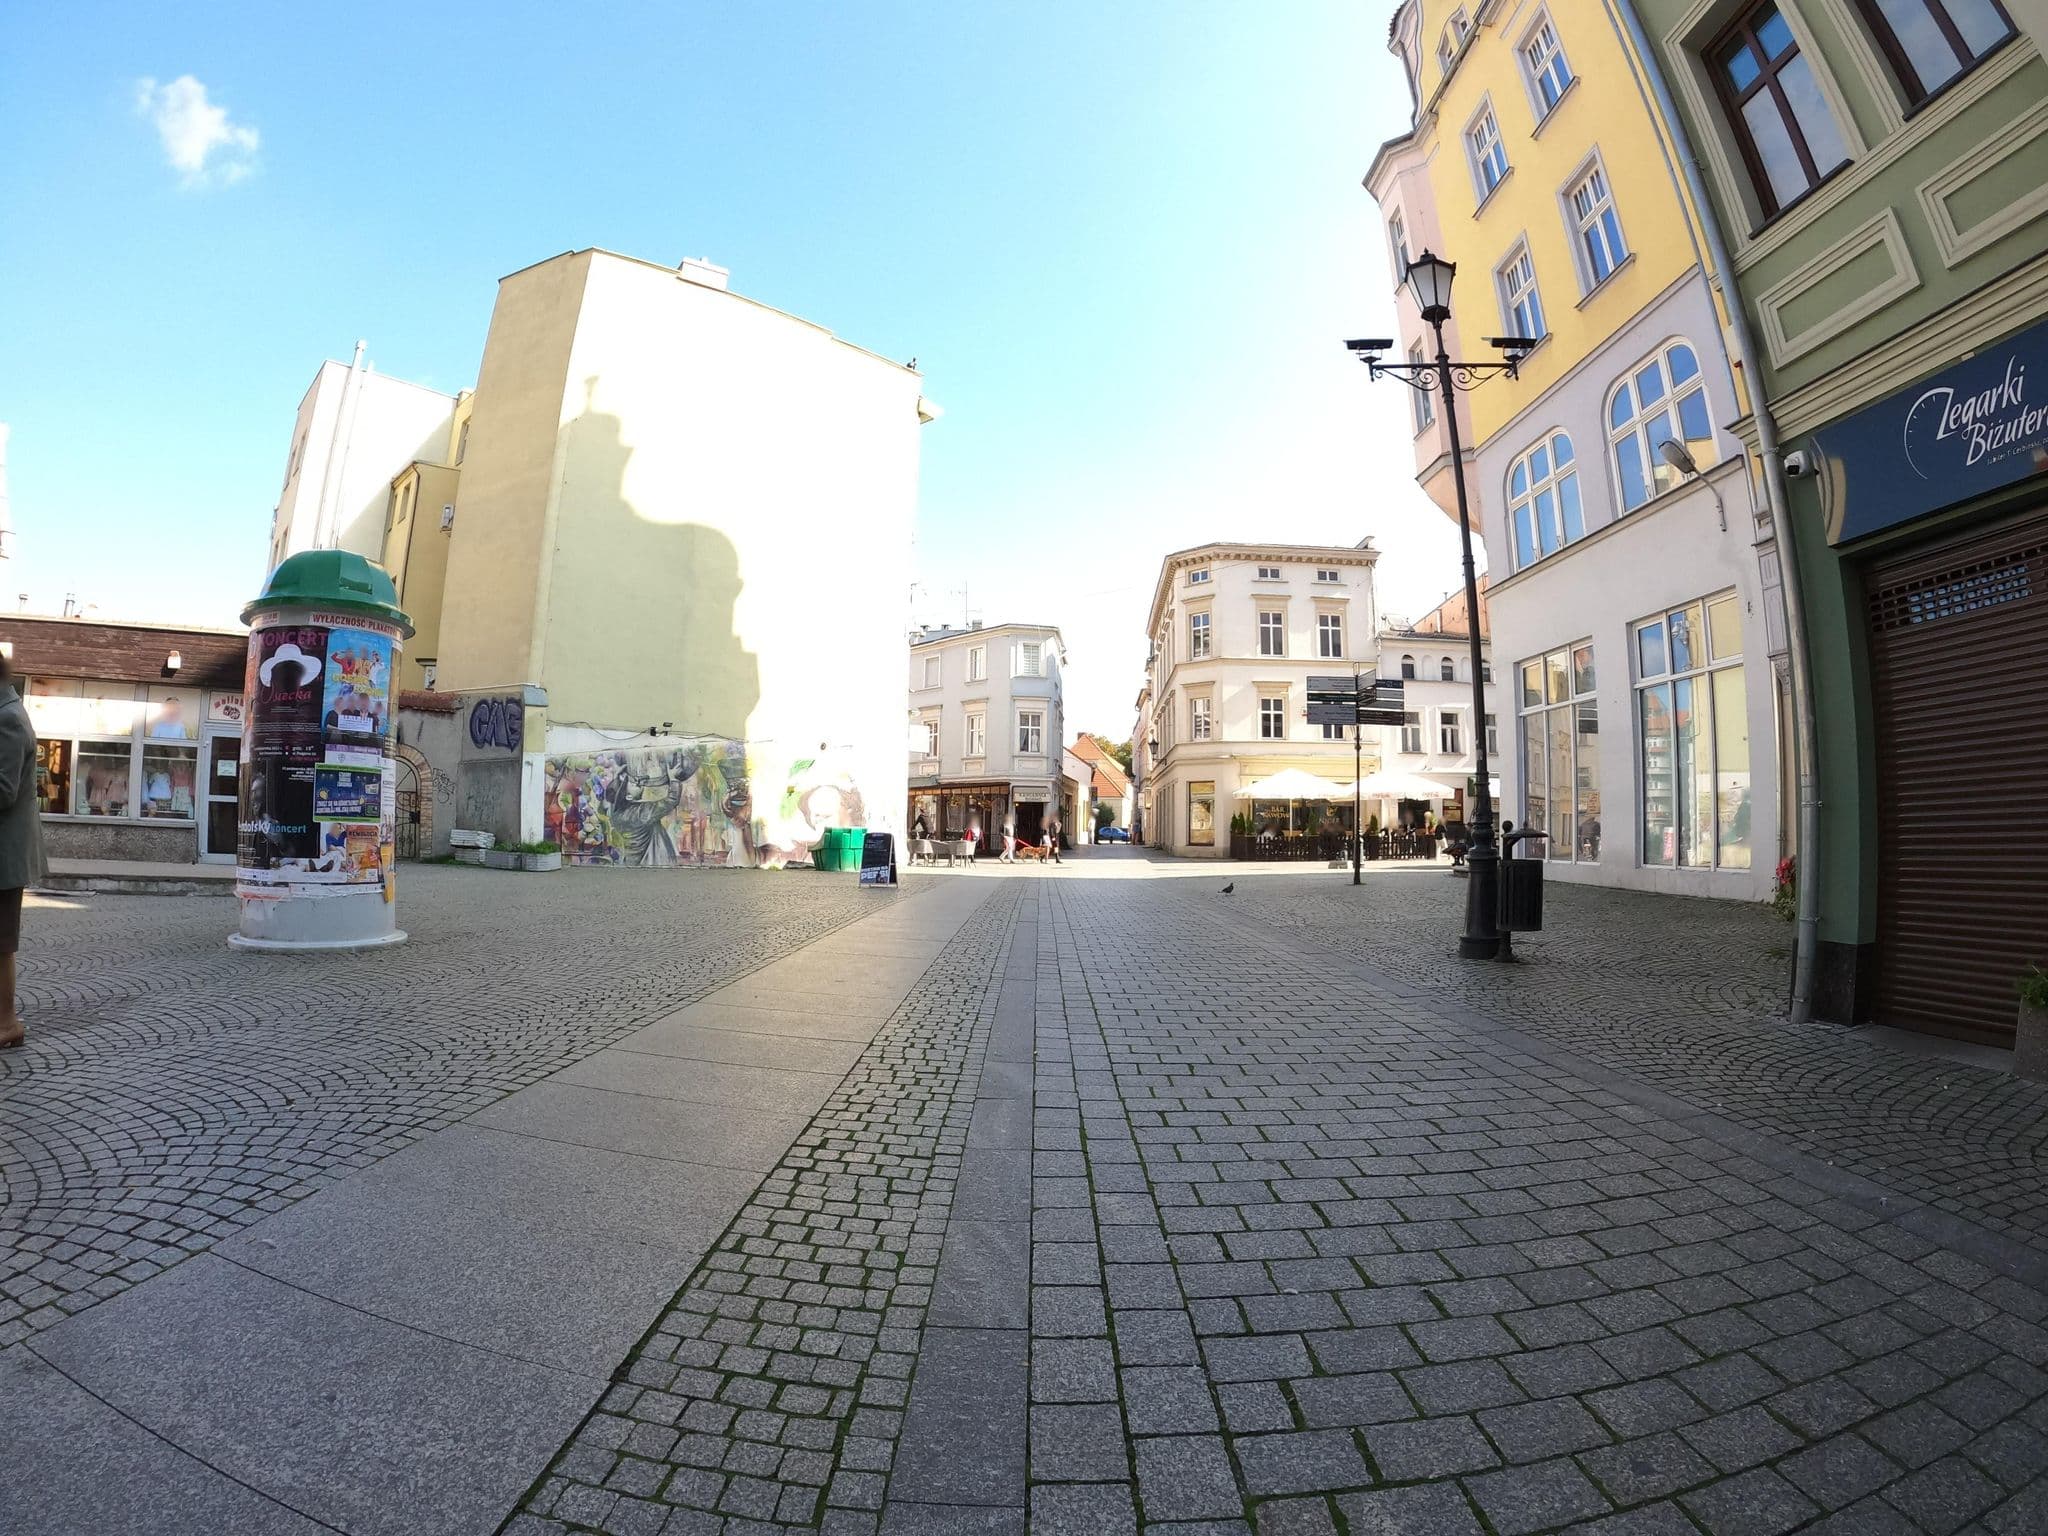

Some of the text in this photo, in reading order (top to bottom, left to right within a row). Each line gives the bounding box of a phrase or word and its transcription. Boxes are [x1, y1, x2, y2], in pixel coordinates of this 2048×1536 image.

[1918, 355, 2025, 442] Zegarki
[1966, 403, 2048, 466] Biżuter
[260, 631, 328, 647] KONCERT
